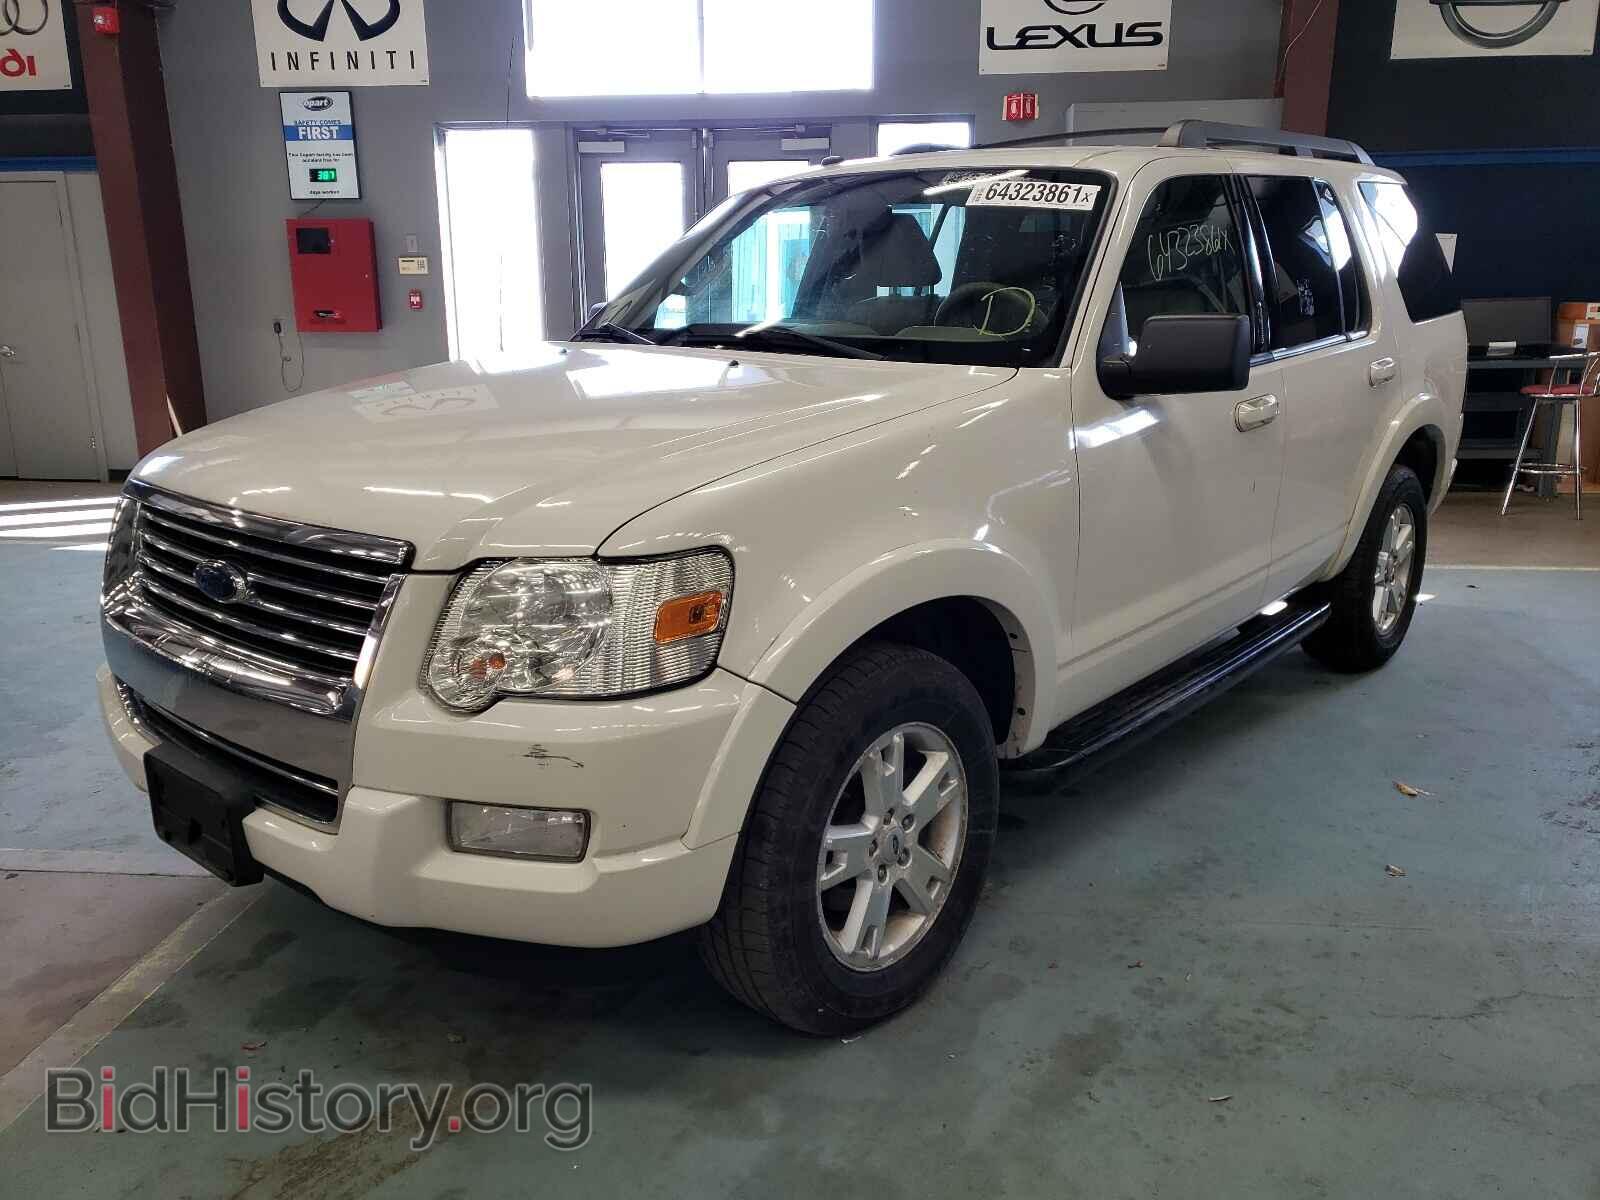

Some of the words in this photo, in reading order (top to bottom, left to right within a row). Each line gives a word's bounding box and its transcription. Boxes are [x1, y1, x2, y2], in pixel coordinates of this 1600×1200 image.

[986, 21, 1164, 50] LEXUS
[0, 48, 36, 77] di
[270, 50, 415, 71] INFINITI
[298, 126, 339, 140] FIRST
